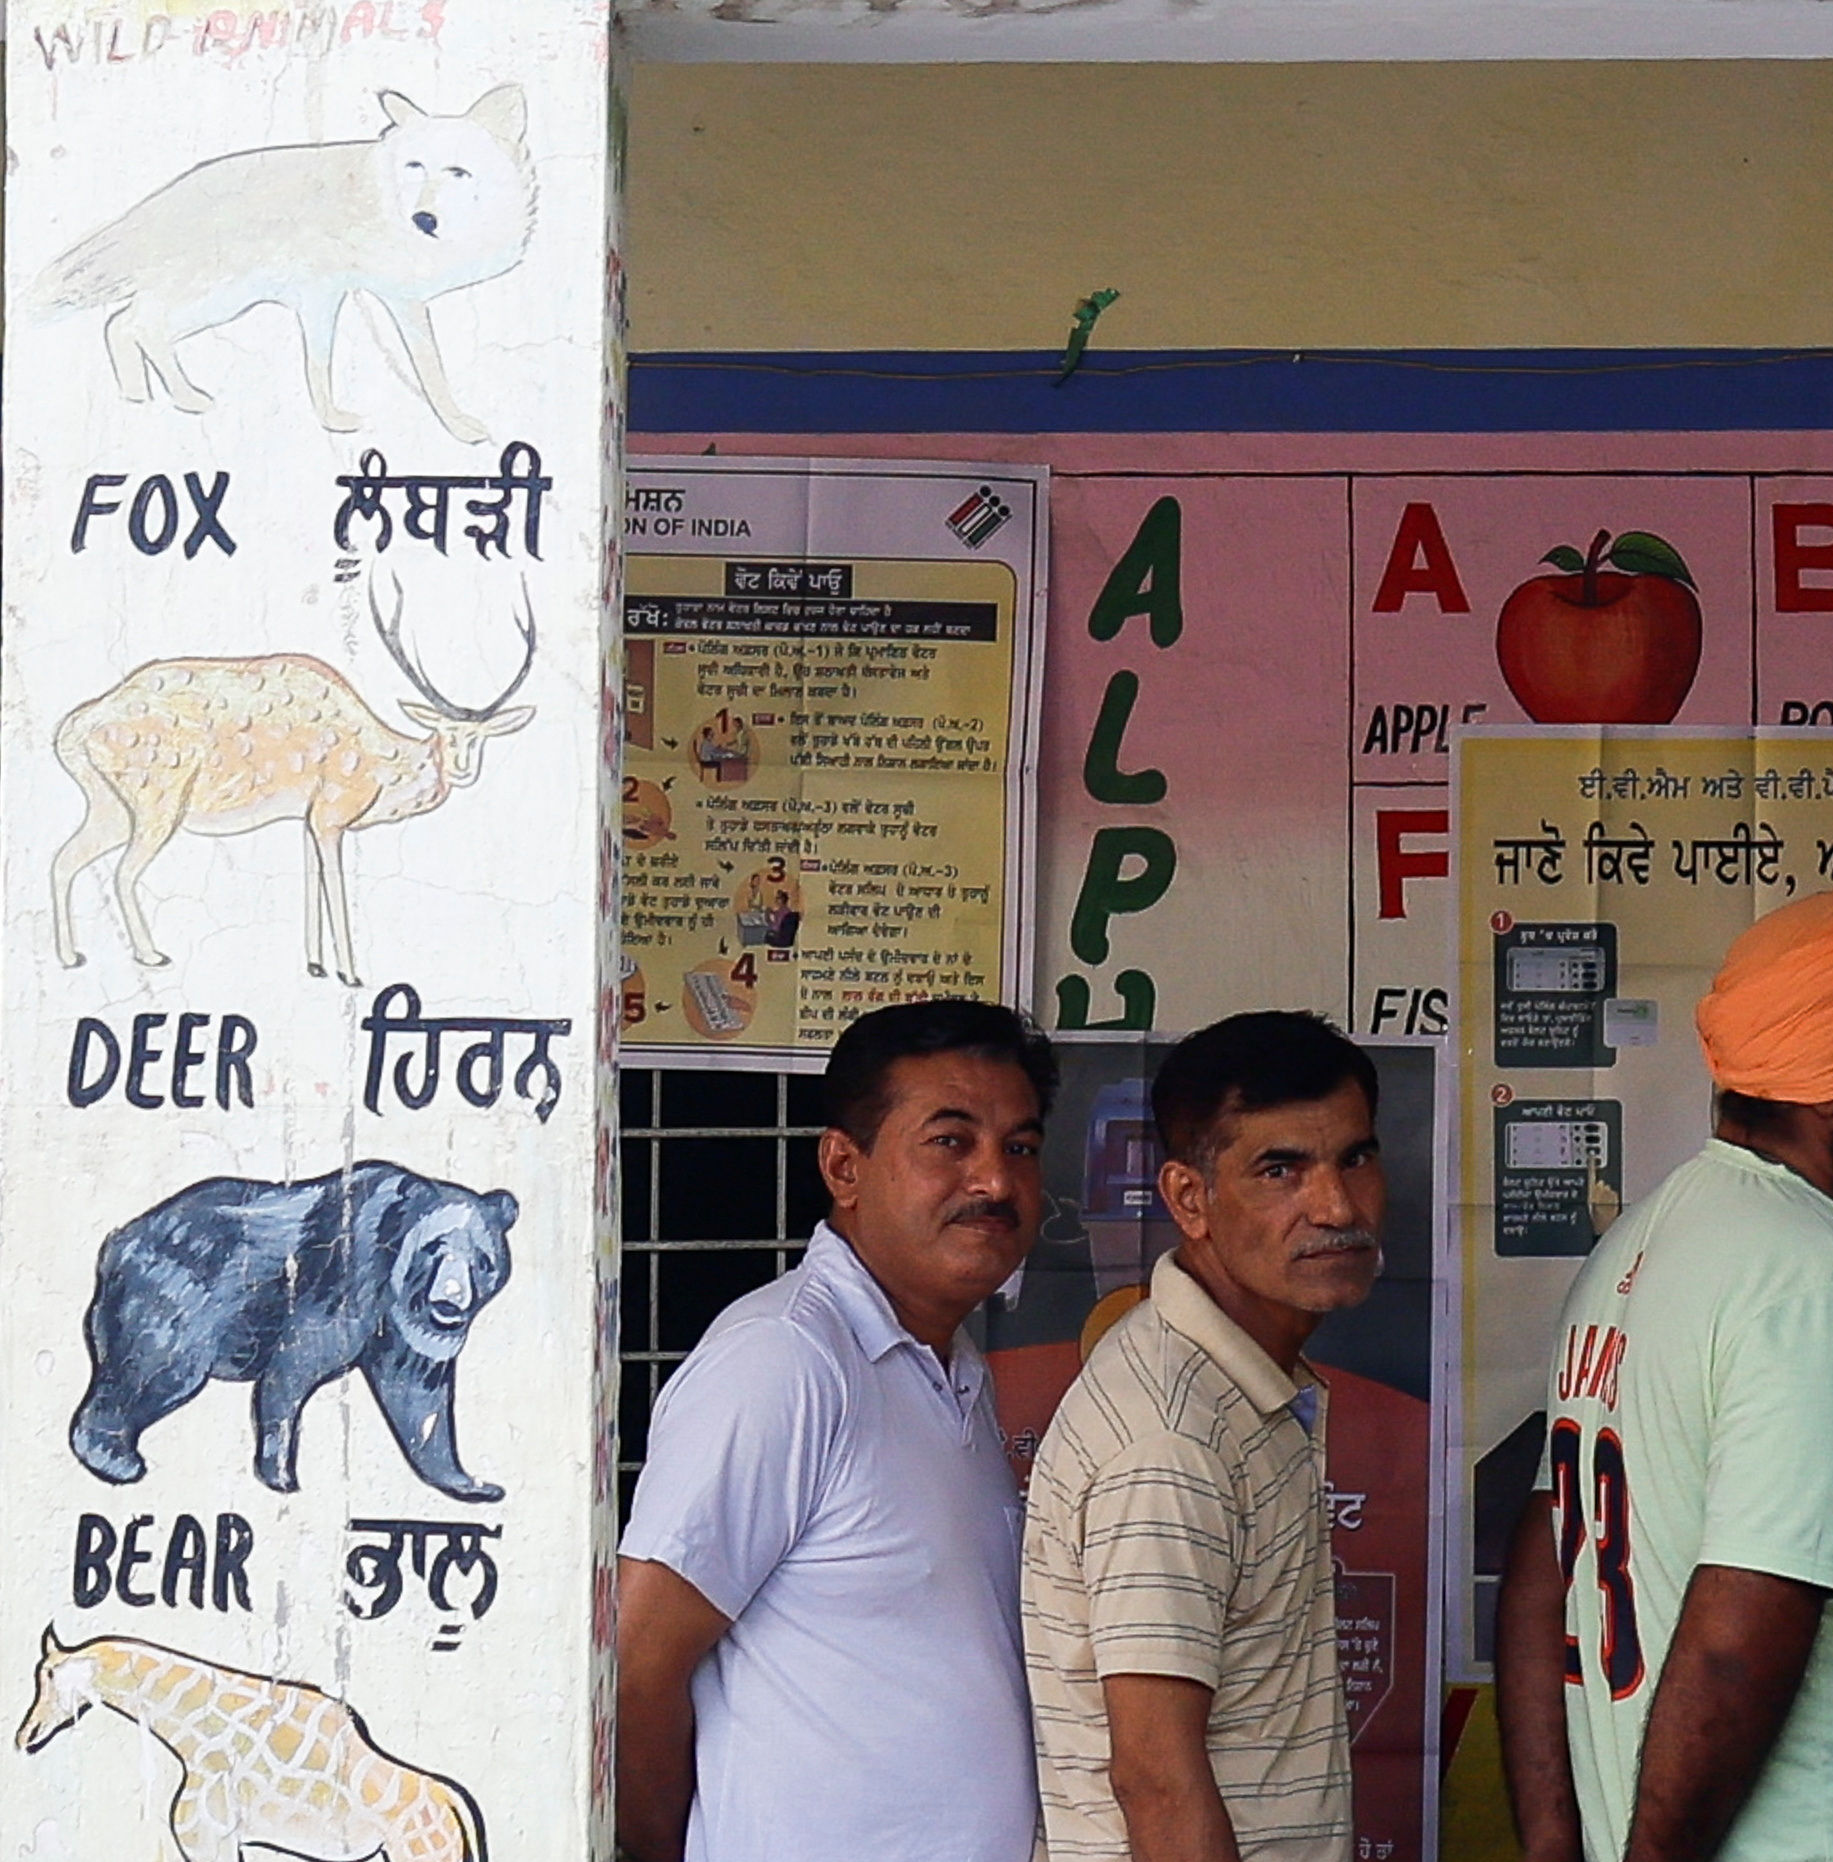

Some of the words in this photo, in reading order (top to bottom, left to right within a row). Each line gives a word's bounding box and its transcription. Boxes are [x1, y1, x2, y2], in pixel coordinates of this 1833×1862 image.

[70, 470, 238, 561] FOX
[652, 517, 685, 537] OF
[690, 518, 752, 538] INDIA
[1372, 502, 1471, 614] A
[734, 566, 761, 591] ਵੋਟ
[715, 708, 732, 734] 1
[1702, 768, 1744, 801] ਅਤੇ
[767, 856, 787, 884] 3
[1376, 810, 1449, 920] F
[1493, 818, 1566, 885] ਜਾਣੋ
[1583, 821, 1655, 885] ਕਿਵੇ
[730, 951, 759, 990] 4
[624, 991, 646, 1024] 5
[67, 1012, 258, 1112] DEER
[73, 1513, 253, 1612] BEAR
